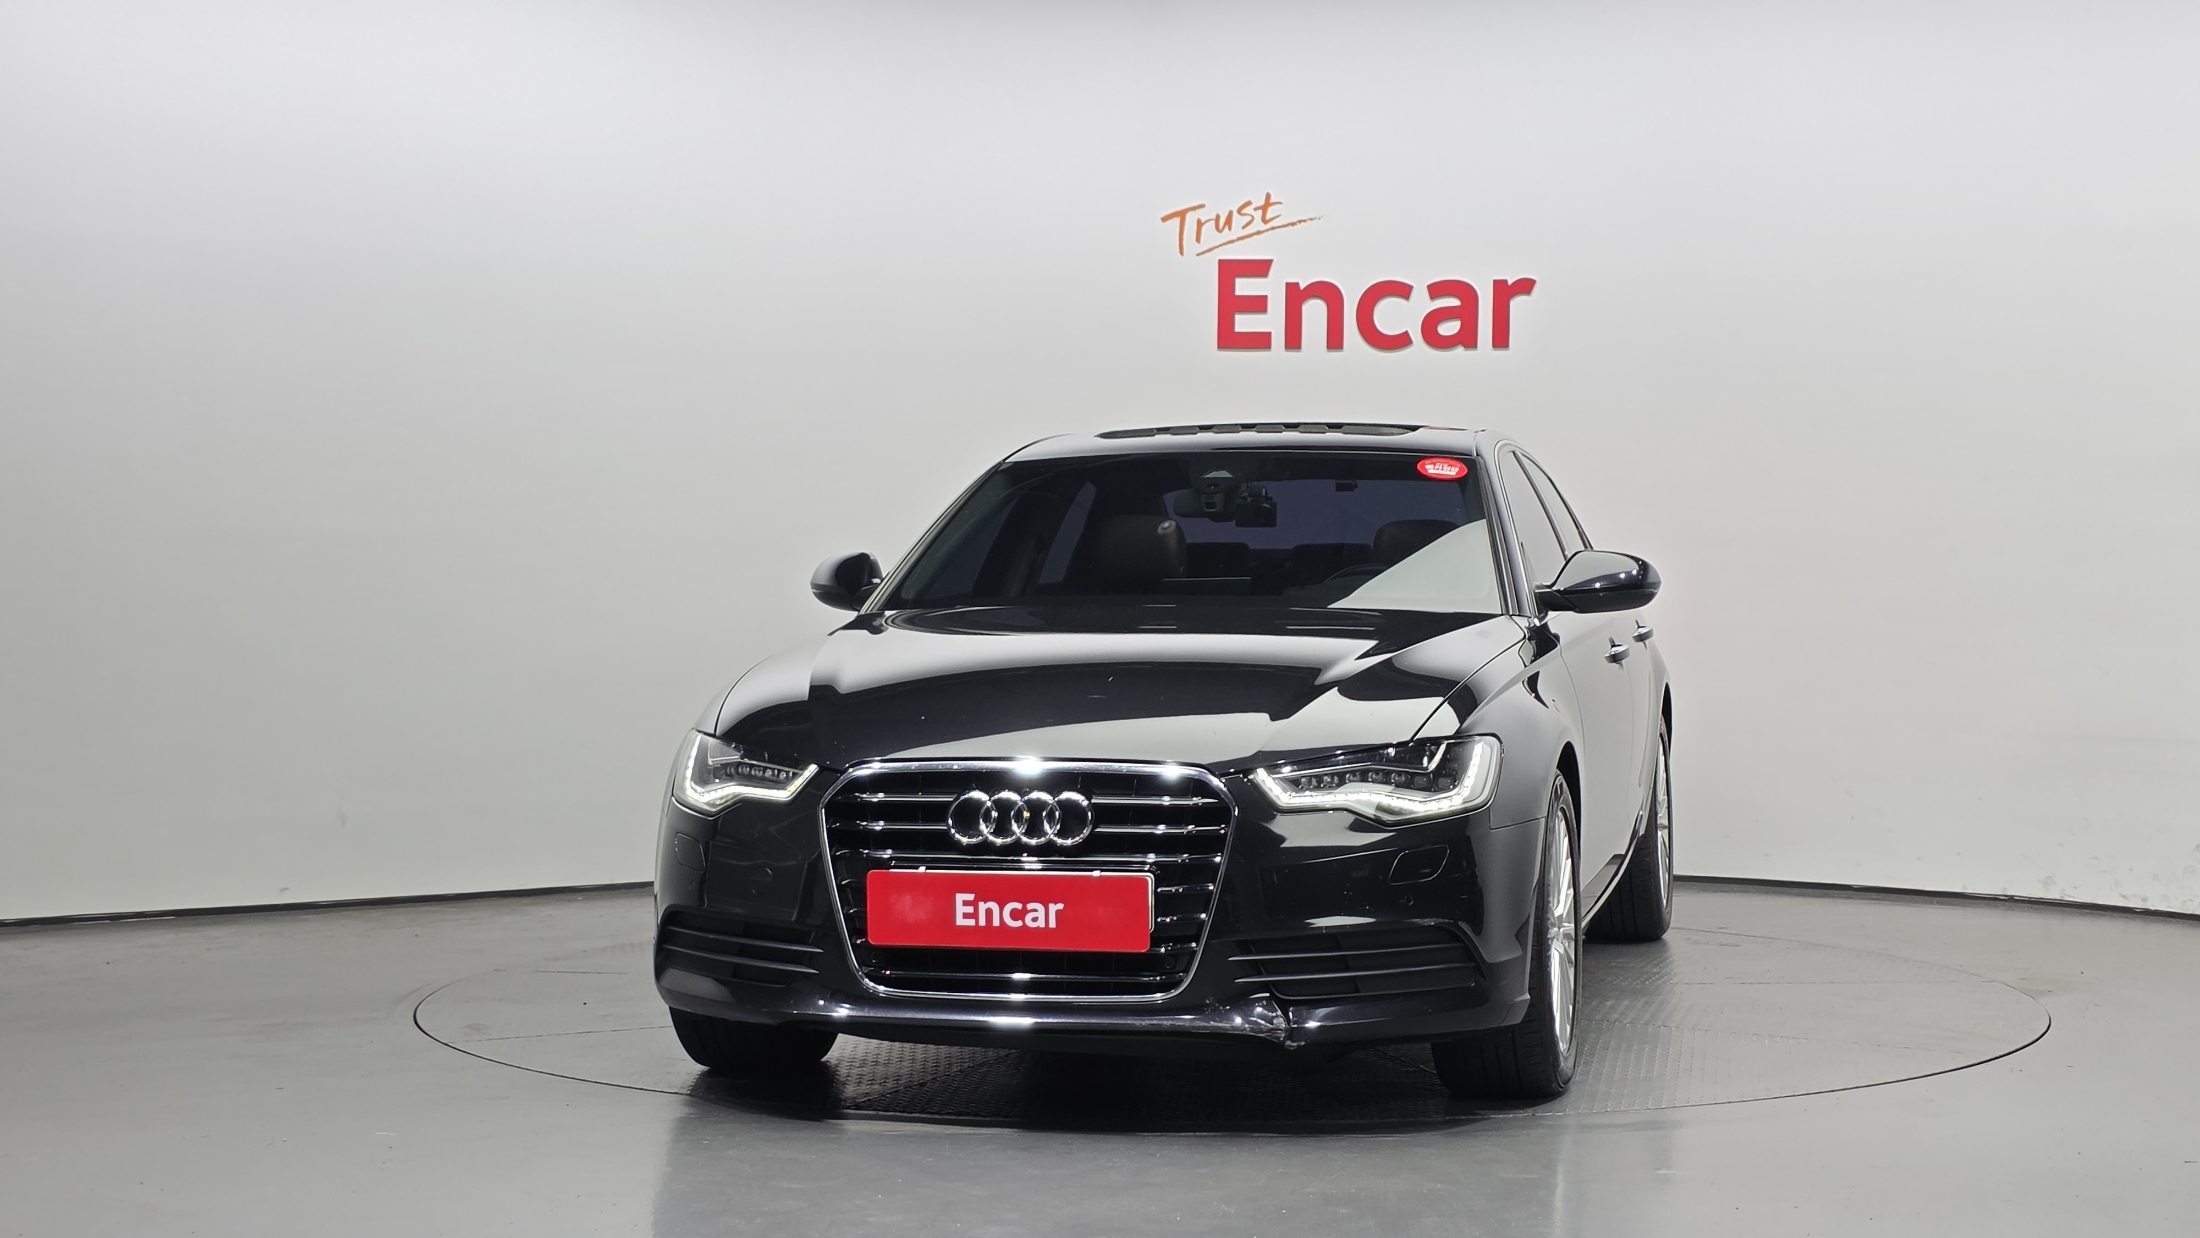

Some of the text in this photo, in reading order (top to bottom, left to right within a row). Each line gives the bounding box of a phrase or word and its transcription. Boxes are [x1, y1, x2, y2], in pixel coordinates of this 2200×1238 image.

[1160, 192, 1283, 256] Trust
[1217, 259, 1536, 351] Encar
[955, 893, 1064, 928] Encar
